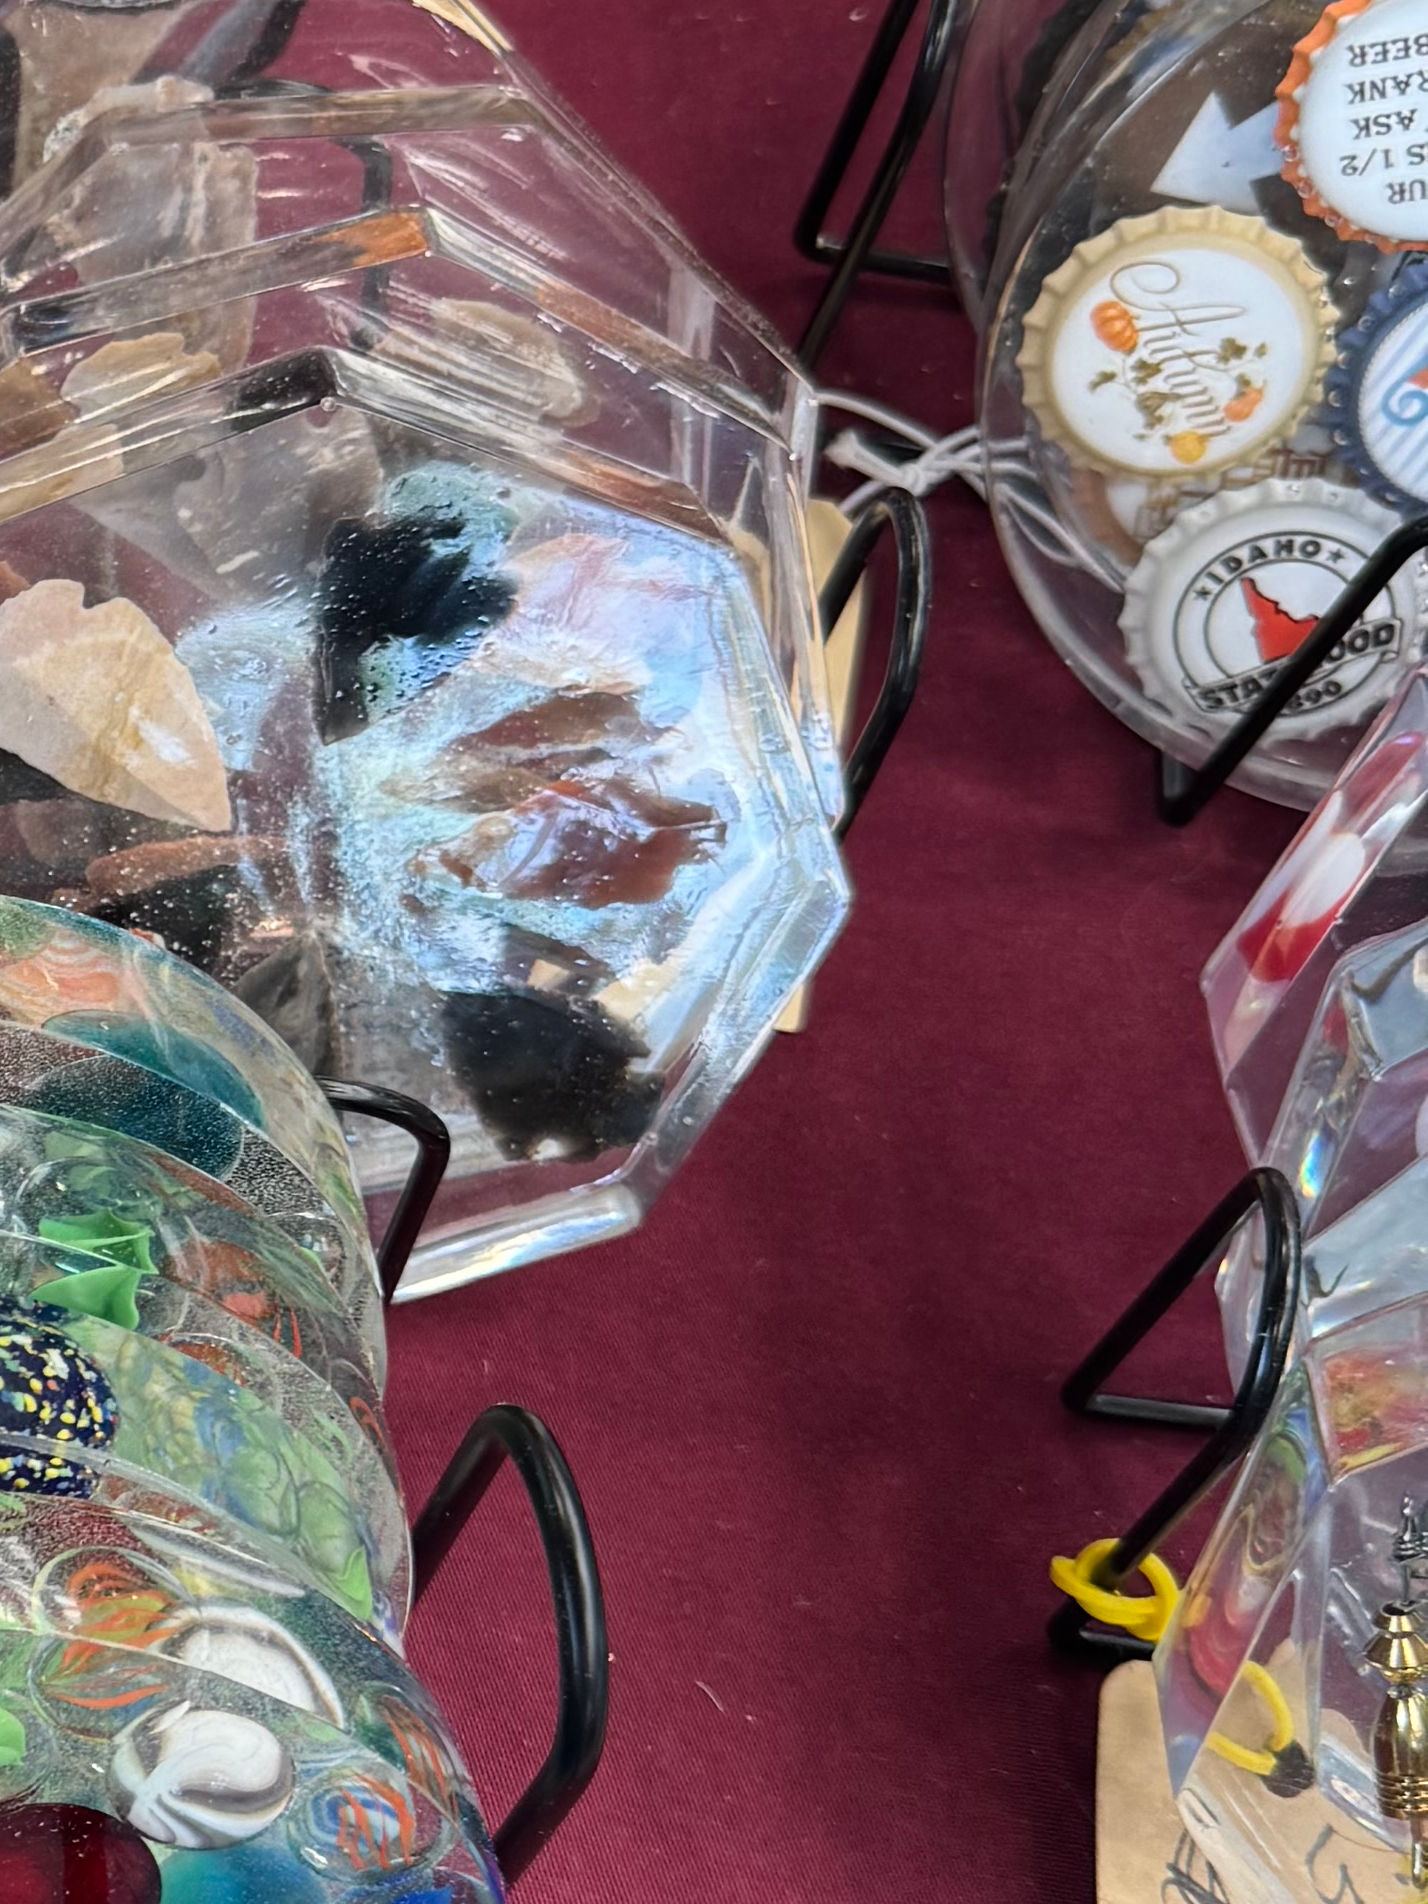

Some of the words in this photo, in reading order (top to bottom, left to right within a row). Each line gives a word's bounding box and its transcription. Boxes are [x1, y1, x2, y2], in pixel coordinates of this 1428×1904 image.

[1345, 69, 1428, 105] RANK
[1348, 108, 1418, 140] ASK
[1338, 148, 1395, 177] 1/2
[1201, 536, 1323, 592] IDAHO
